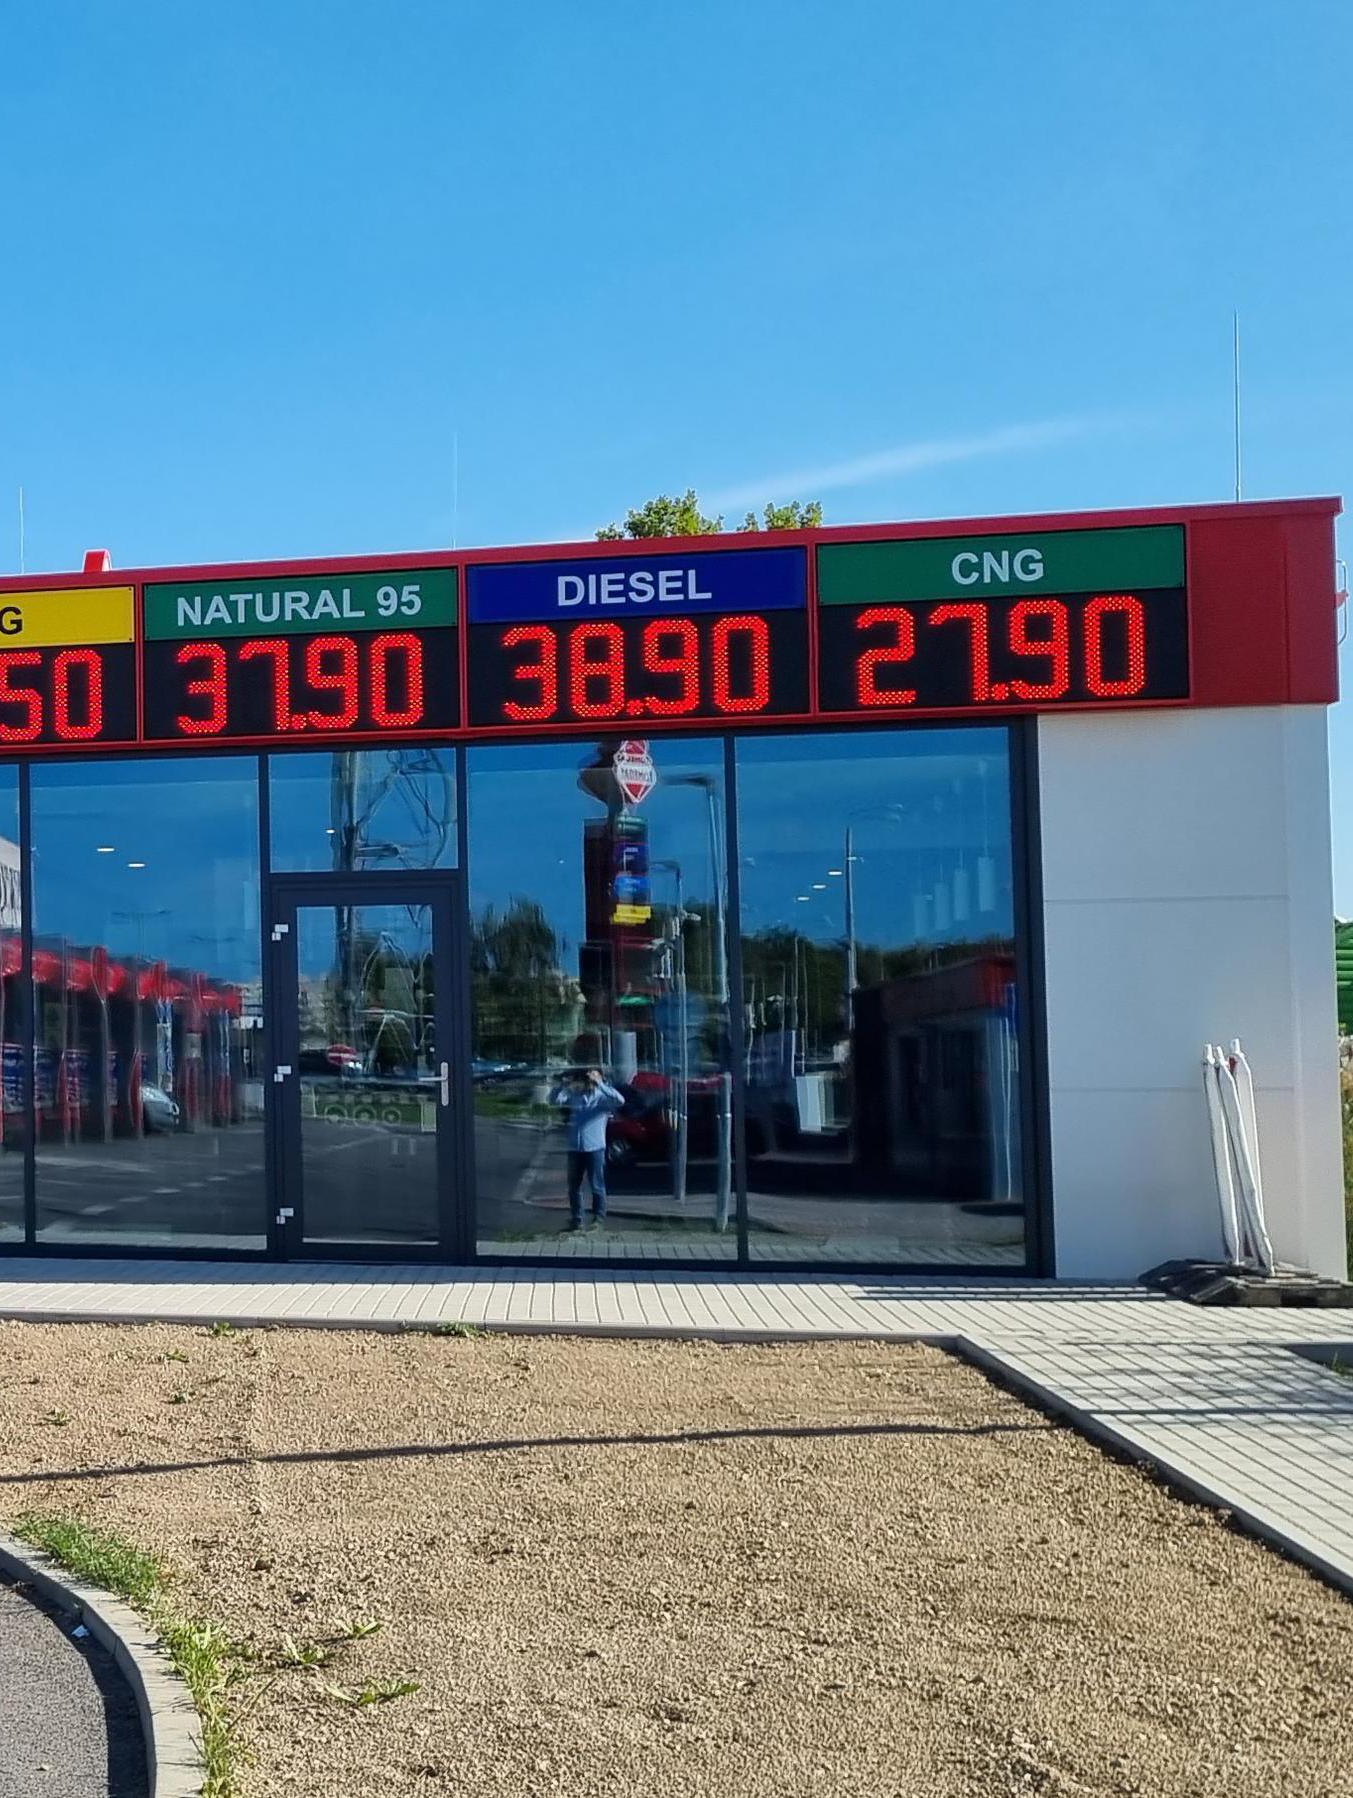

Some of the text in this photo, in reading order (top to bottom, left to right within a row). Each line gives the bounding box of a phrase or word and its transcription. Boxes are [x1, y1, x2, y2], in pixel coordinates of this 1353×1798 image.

[557, 569, 713, 607] DIESEL
[951, 548, 1045, 585] CNG
[177, 584, 422, 627] NATURAL 95
[176, 633, 424, 734] 37.90
[501, 615, 771, 720] 38.90
[856, 595, 1146, 706] 27.90
